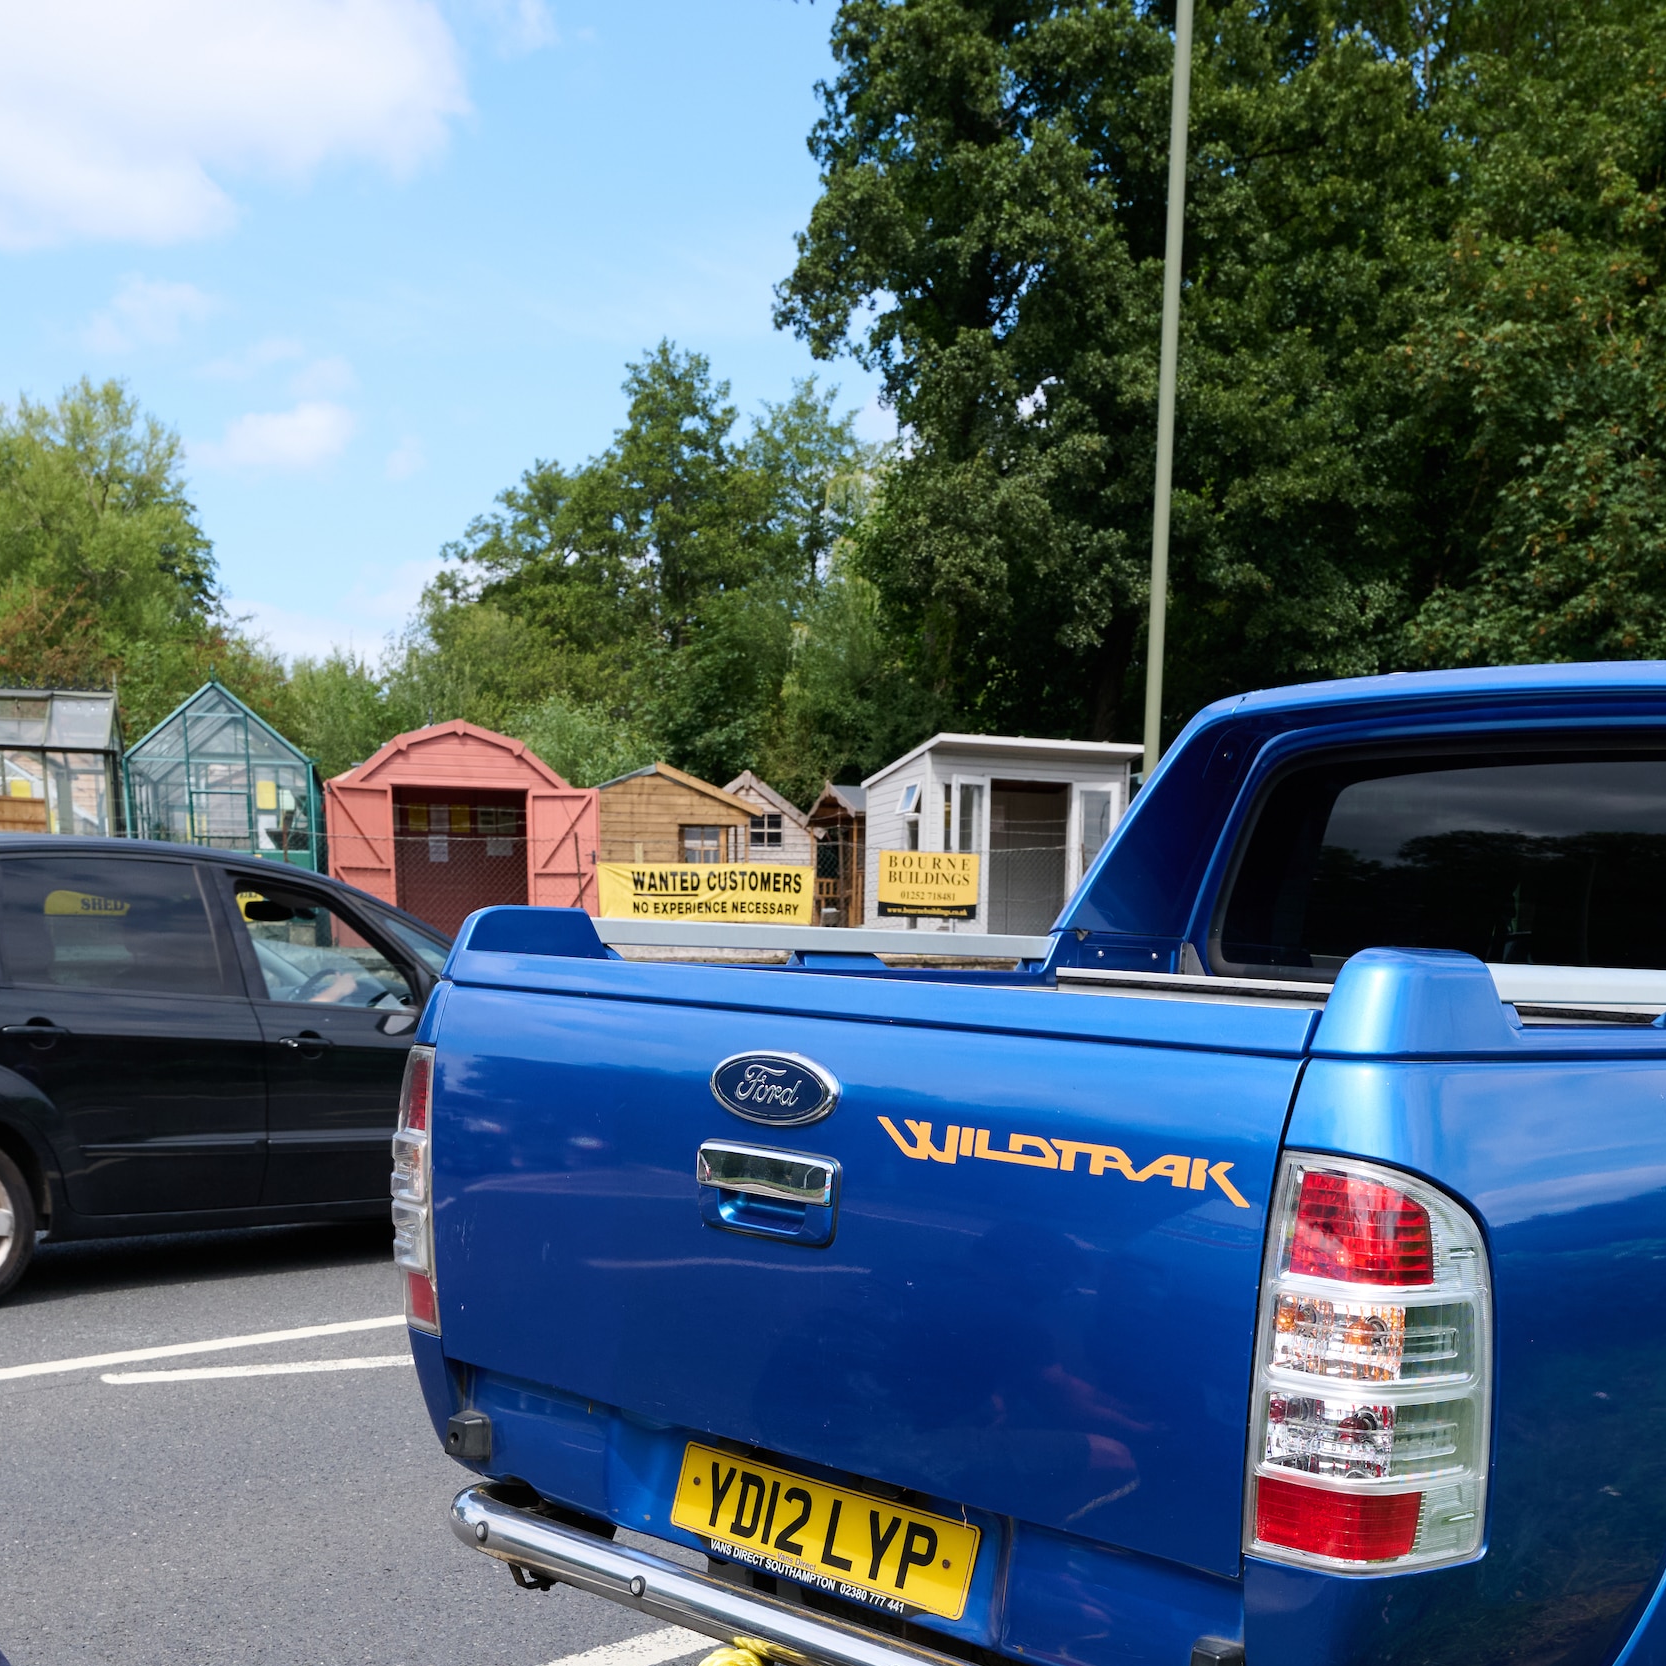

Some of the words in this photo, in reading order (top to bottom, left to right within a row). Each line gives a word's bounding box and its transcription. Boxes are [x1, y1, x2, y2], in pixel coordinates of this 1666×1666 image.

[889, 855, 971, 872] BOURNE
[632, 871, 700, 892] WANTED
[707, 871, 802, 894] CUSTOMERS
[888, 870, 971, 887] BUILDINGS
[900, 891, 925, 901] 01252
[633, 902, 649, 914] NO
[654, 902, 727, 915] EXPERIENCE
[732, 902, 799, 916] NECESSARY
[735, 1064, 803, 1107] Ford
[876, 1115, 1251, 1208] WILDTRAK
[708, 1460, 813, 1558] YD12
[821, 1496, 939, 1590] LYP
[776, 1551, 794, 1565] Vans
[794, 1557, 817, 1572] Direct
[710, 1538, 732, 1555] VANS
[733, 1546, 765, 1567] DIRECT
[765, 1556, 836, 1591] SOUTHAMPTON
[839, 1583, 868, 1602] 02380
[869, 1592, 887, 1608] 777
[887, 1598, 905, 1613] 441
